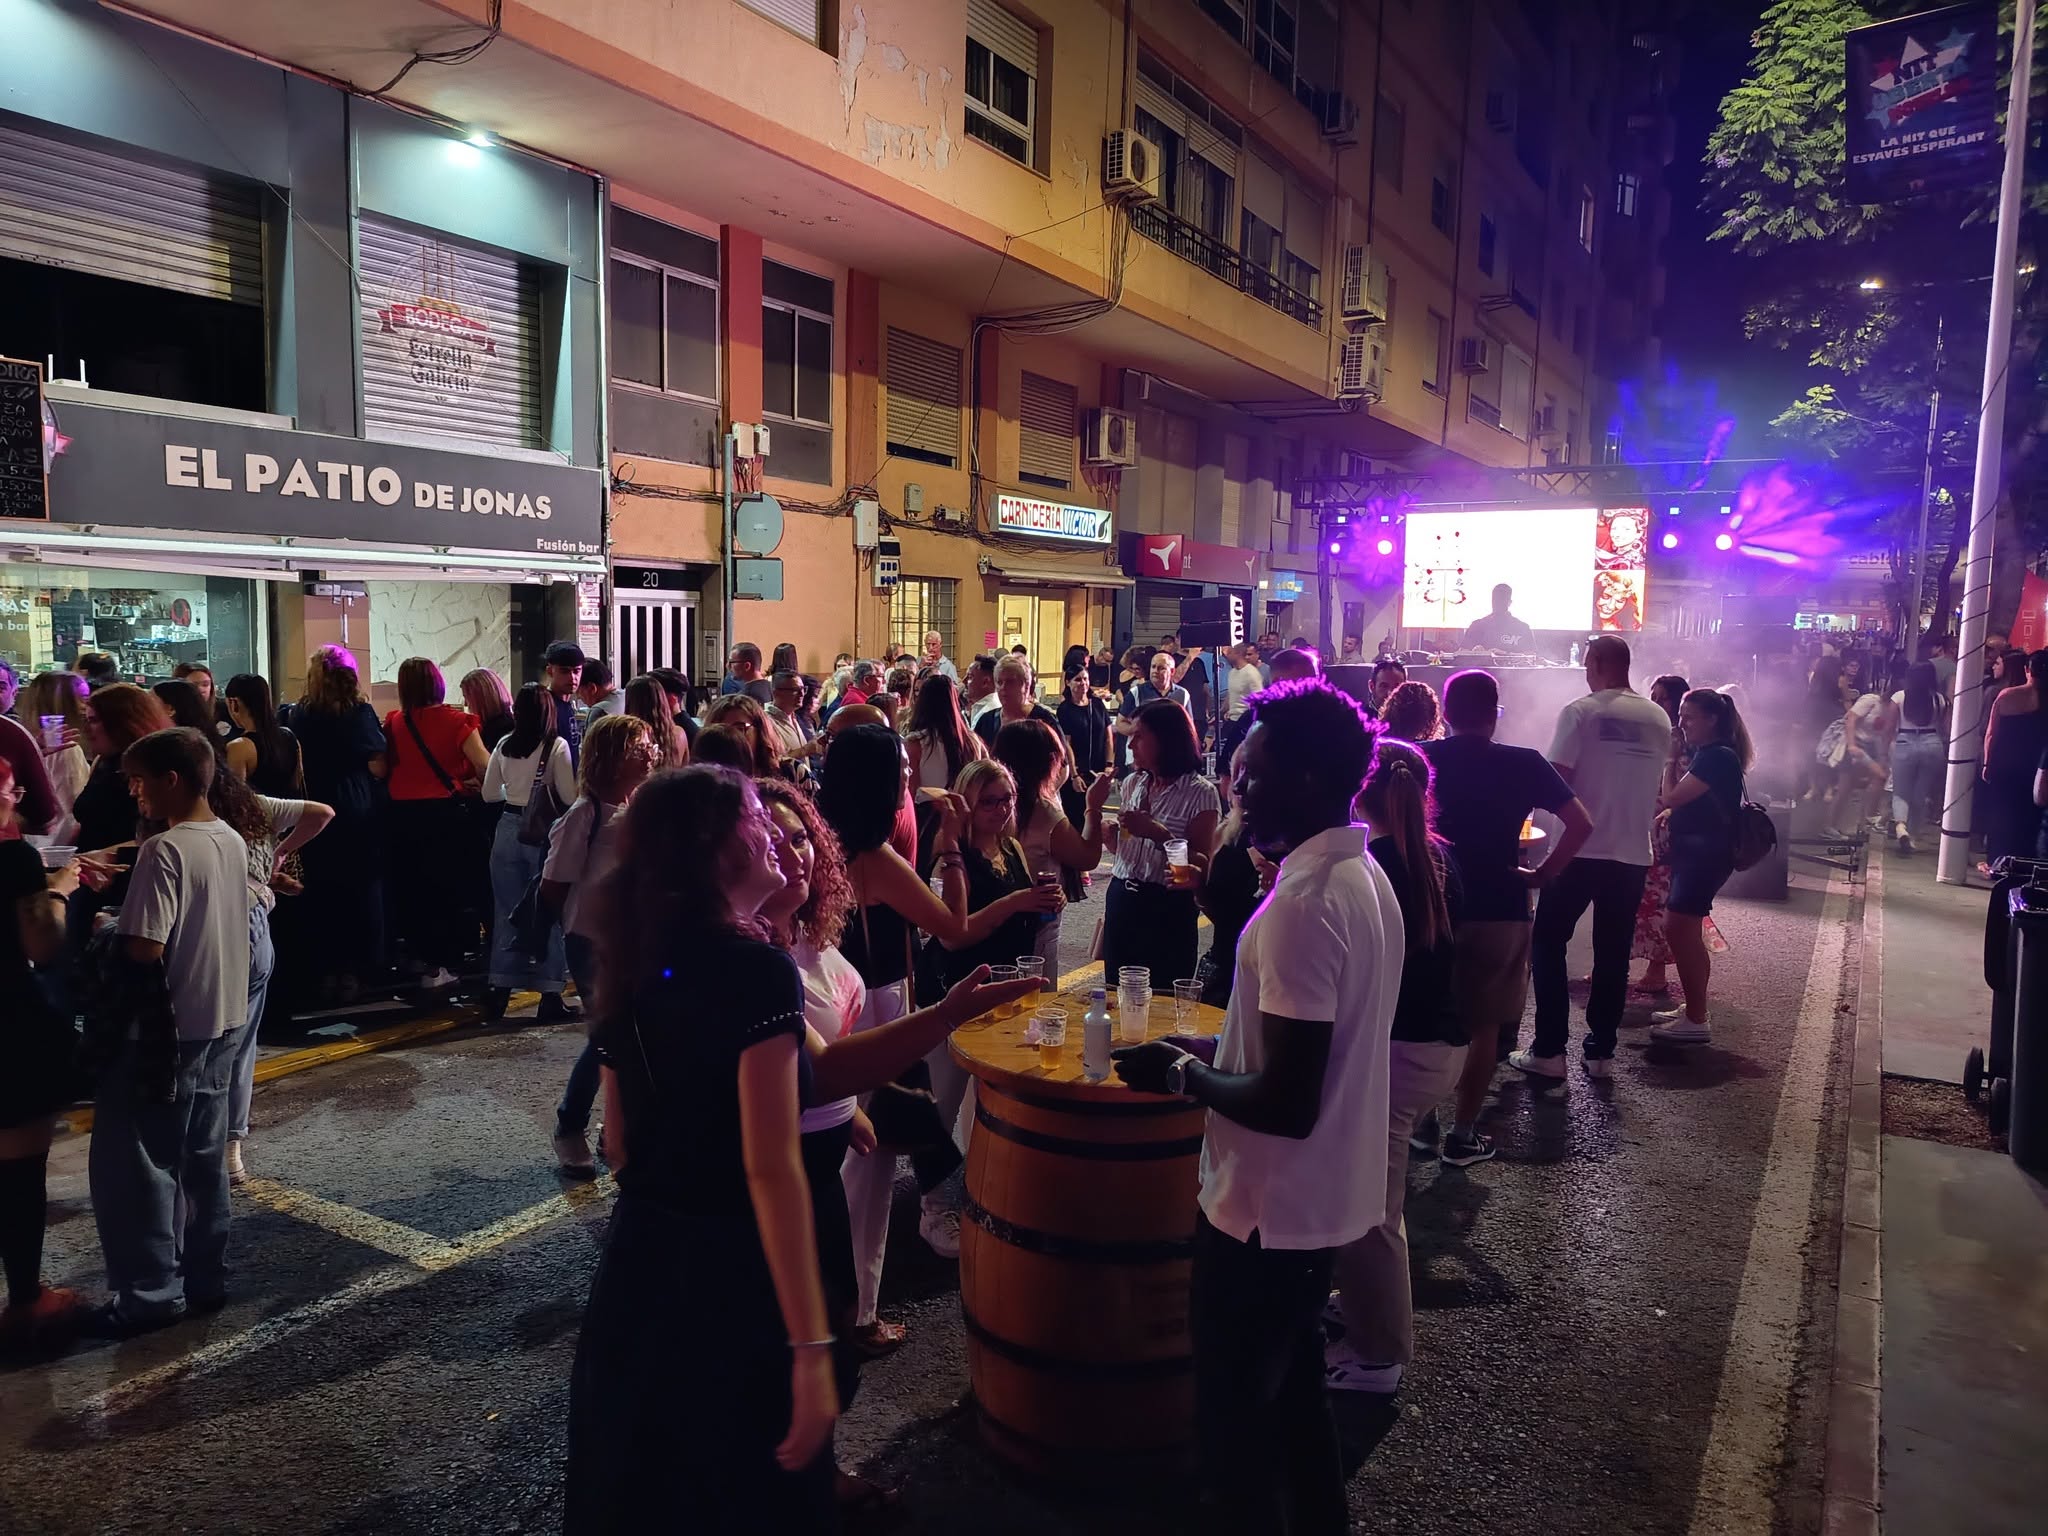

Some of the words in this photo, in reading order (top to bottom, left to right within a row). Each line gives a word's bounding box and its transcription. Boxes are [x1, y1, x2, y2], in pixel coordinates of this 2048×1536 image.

[1852, 146, 1909, 164] ESTAVES
[1912, 131, 1985, 154] ESPERANT
[1880, 137, 1899, 148] LA
[1902, 131, 1926, 144] NIT
[1928, 125, 1957, 138] QUE
[408, 337, 472, 369] Estrella
[410, 360, 471, 392] Galicia
[165, 444, 233, 491] EL
[245, 453, 402, 506] PATIO
[414, 481, 454, 511] DE
[460, 487, 552, 520] JONAS
[1063, 509, 1096, 538] VICTOR
[536, 538, 577, 553] Fusión
[578, 540, 600, 554] bar
[642, 571, 659, 587] 20
